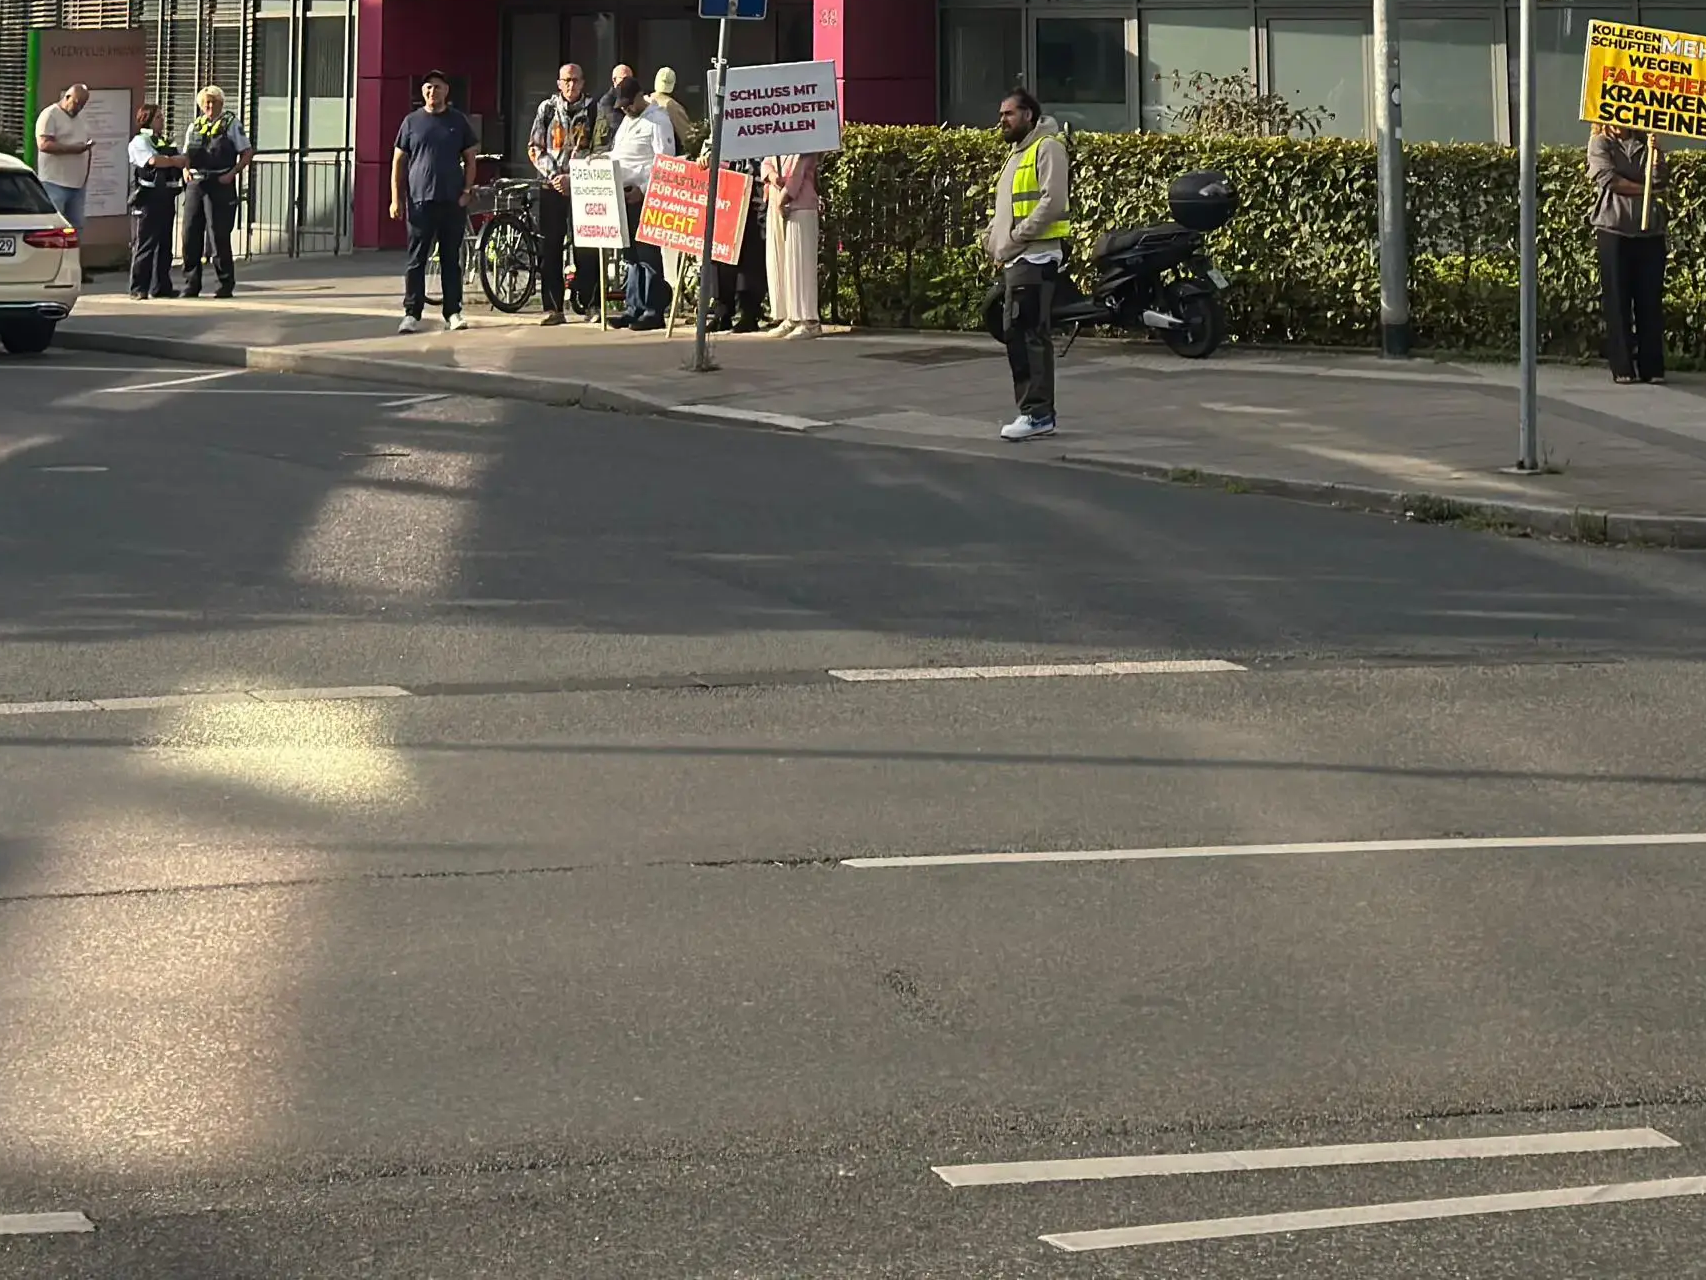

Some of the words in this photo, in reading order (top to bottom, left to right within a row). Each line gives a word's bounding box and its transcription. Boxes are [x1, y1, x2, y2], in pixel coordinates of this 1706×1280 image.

[1592, 24, 1662, 43] KOLLEGEN
[1591, 36, 1662, 55] SCHUFTEN
[1629, 54, 1692, 75] WEGEN
[730, 85, 791, 102] SCHLUSS
[793, 83, 818, 97] MIT
[724, 99, 836, 120] NBEGRÜNDETEN
[737, 119, 816, 137] AUSFÄLLEN
[656, 158, 686, 173] MEHR
[651, 181, 672, 197] FÜR
[654, 170, 709, 192] BELASTUN
[643, 208, 698, 234] NICHT
